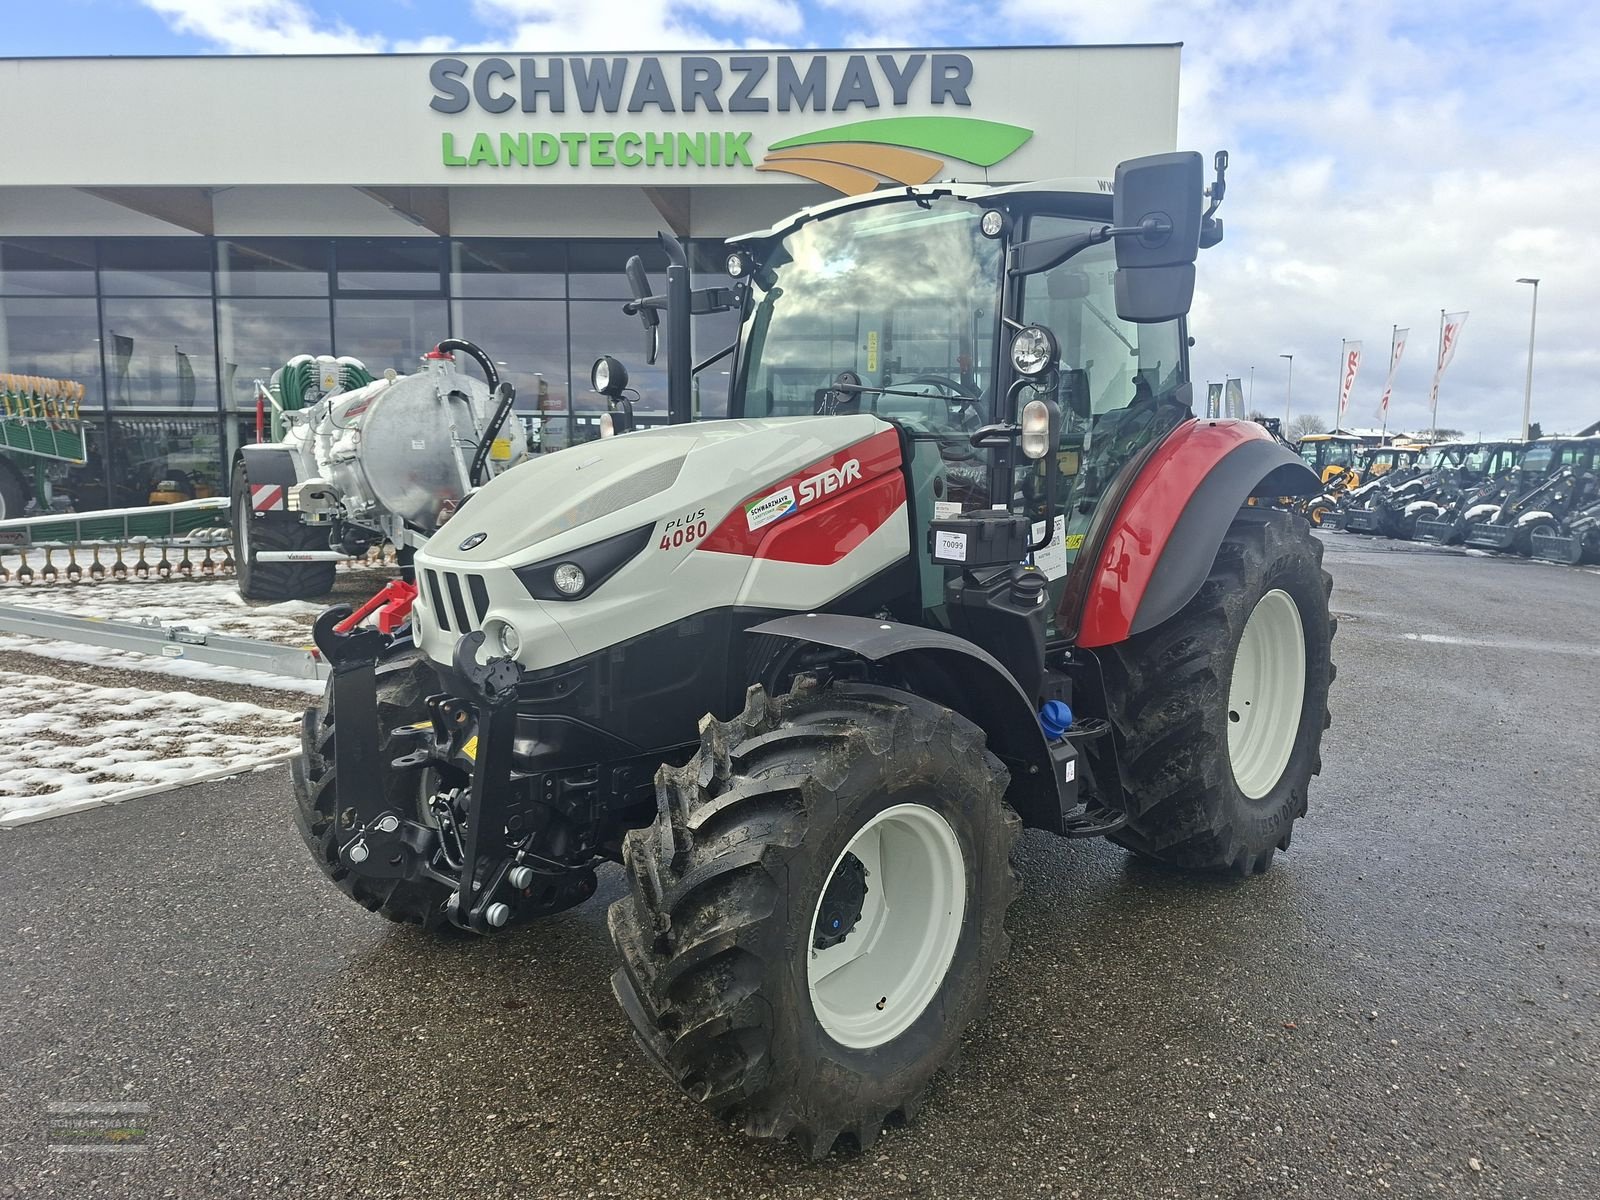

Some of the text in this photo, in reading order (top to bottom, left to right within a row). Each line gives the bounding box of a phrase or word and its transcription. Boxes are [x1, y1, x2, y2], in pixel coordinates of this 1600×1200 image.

[429, 54, 973, 114] SCHWARZMAYR
[441, 131, 754, 167] LANDTECHNIK
[798, 458, 862, 506] STEYR
[665, 508, 706, 532] PLUS
[750, 495, 788, 516] SCHWARZMAYR
[659, 520, 708, 551] 4080
